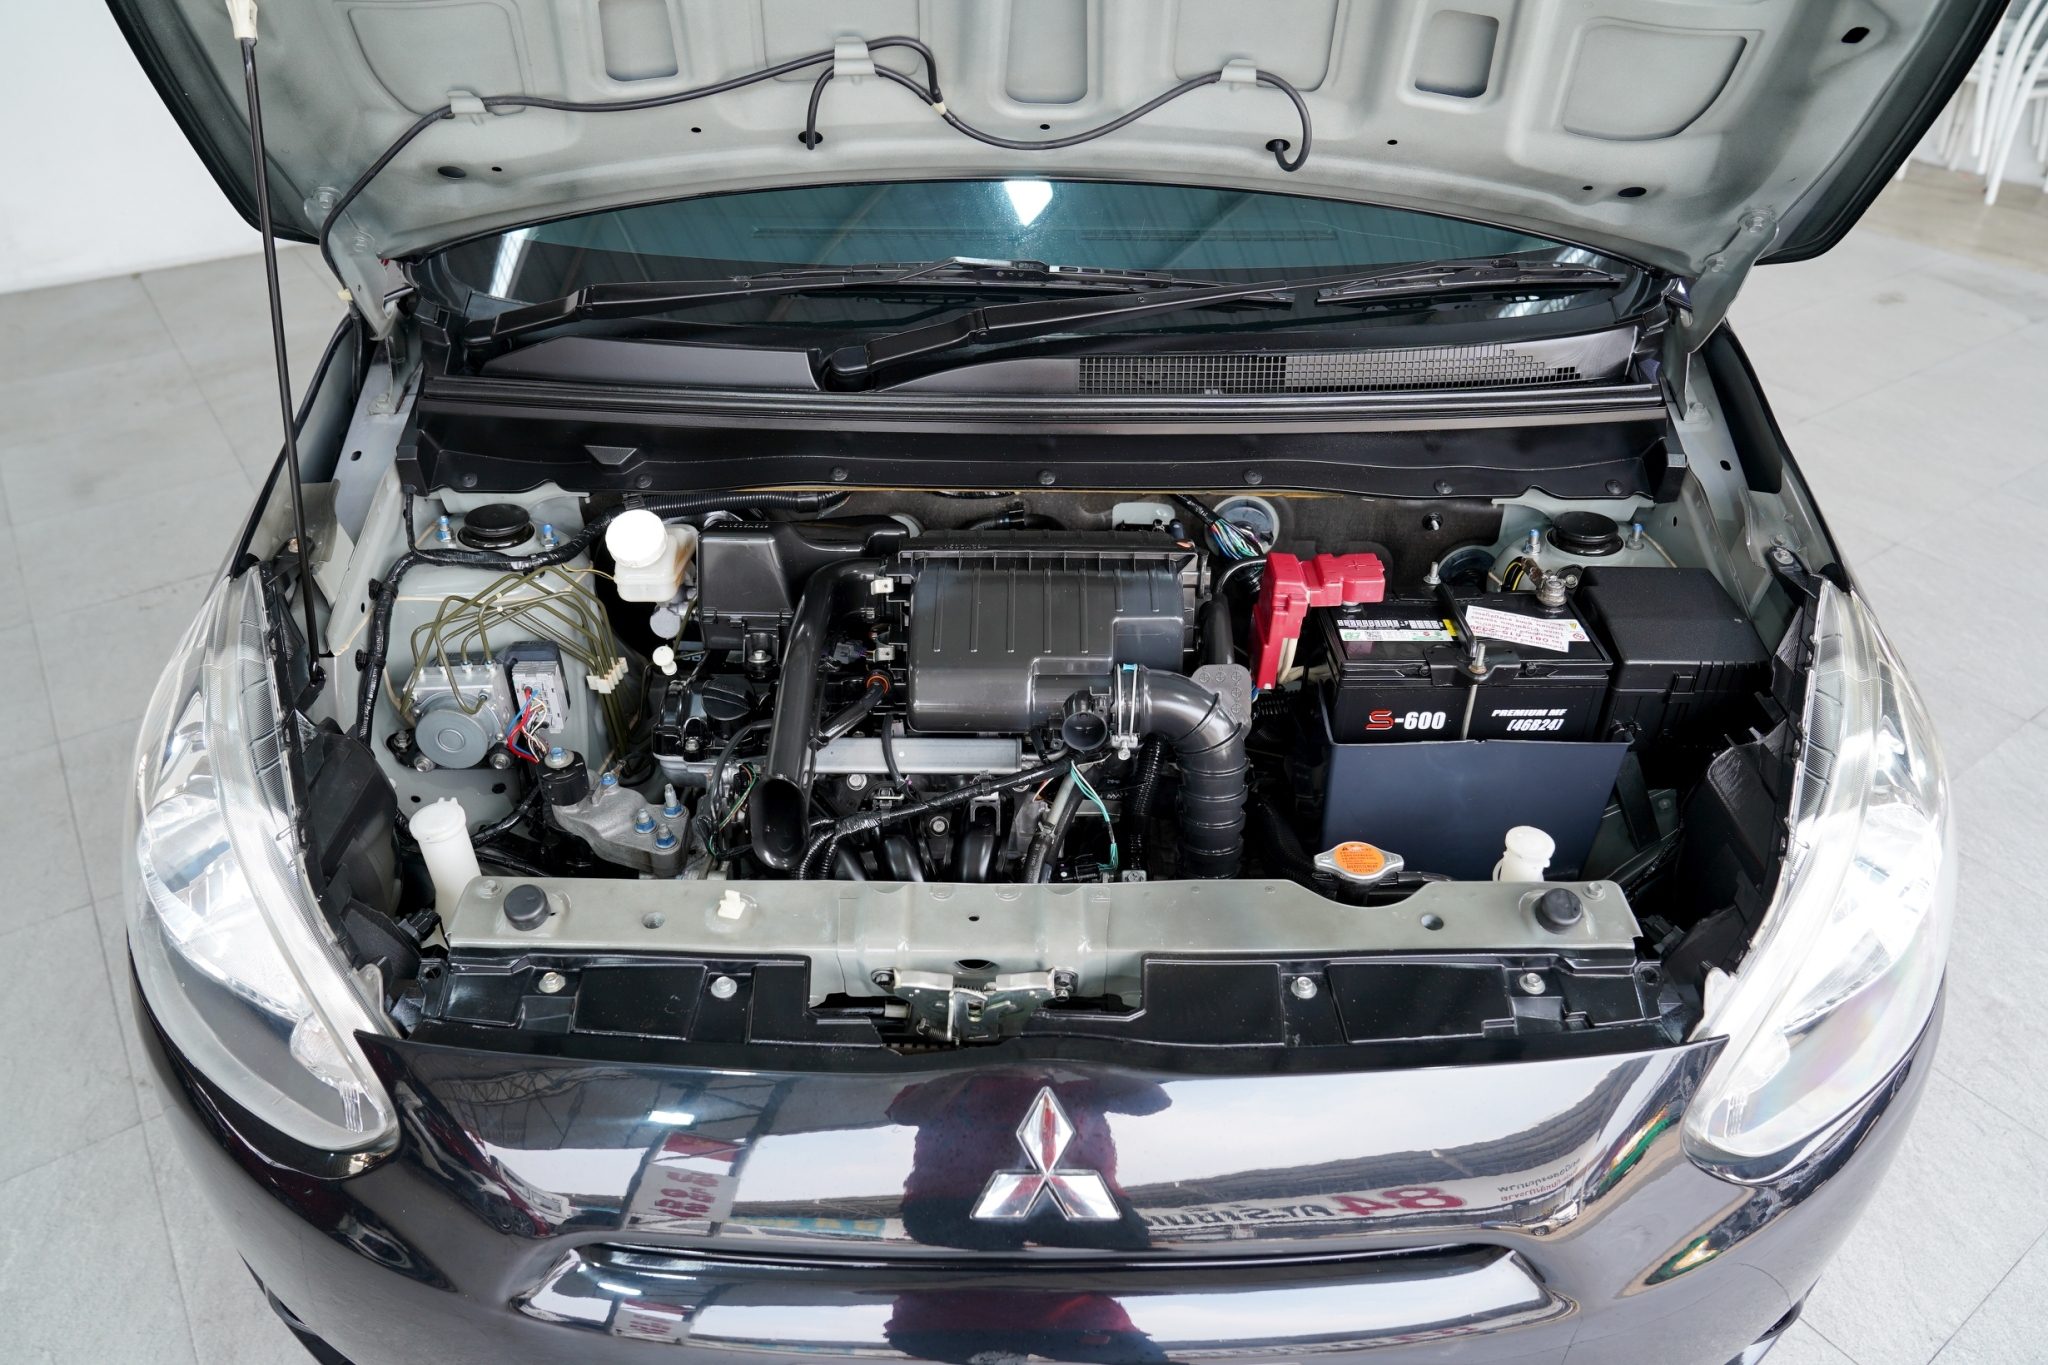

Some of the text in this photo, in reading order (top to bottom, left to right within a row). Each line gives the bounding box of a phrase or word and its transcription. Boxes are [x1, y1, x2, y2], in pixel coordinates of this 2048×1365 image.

[1366, 709, 1446, 730] S-600
[1491, 709, 1568, 717] PREMIUM MF
[1506, 718, 1565, 732] (46B24)
